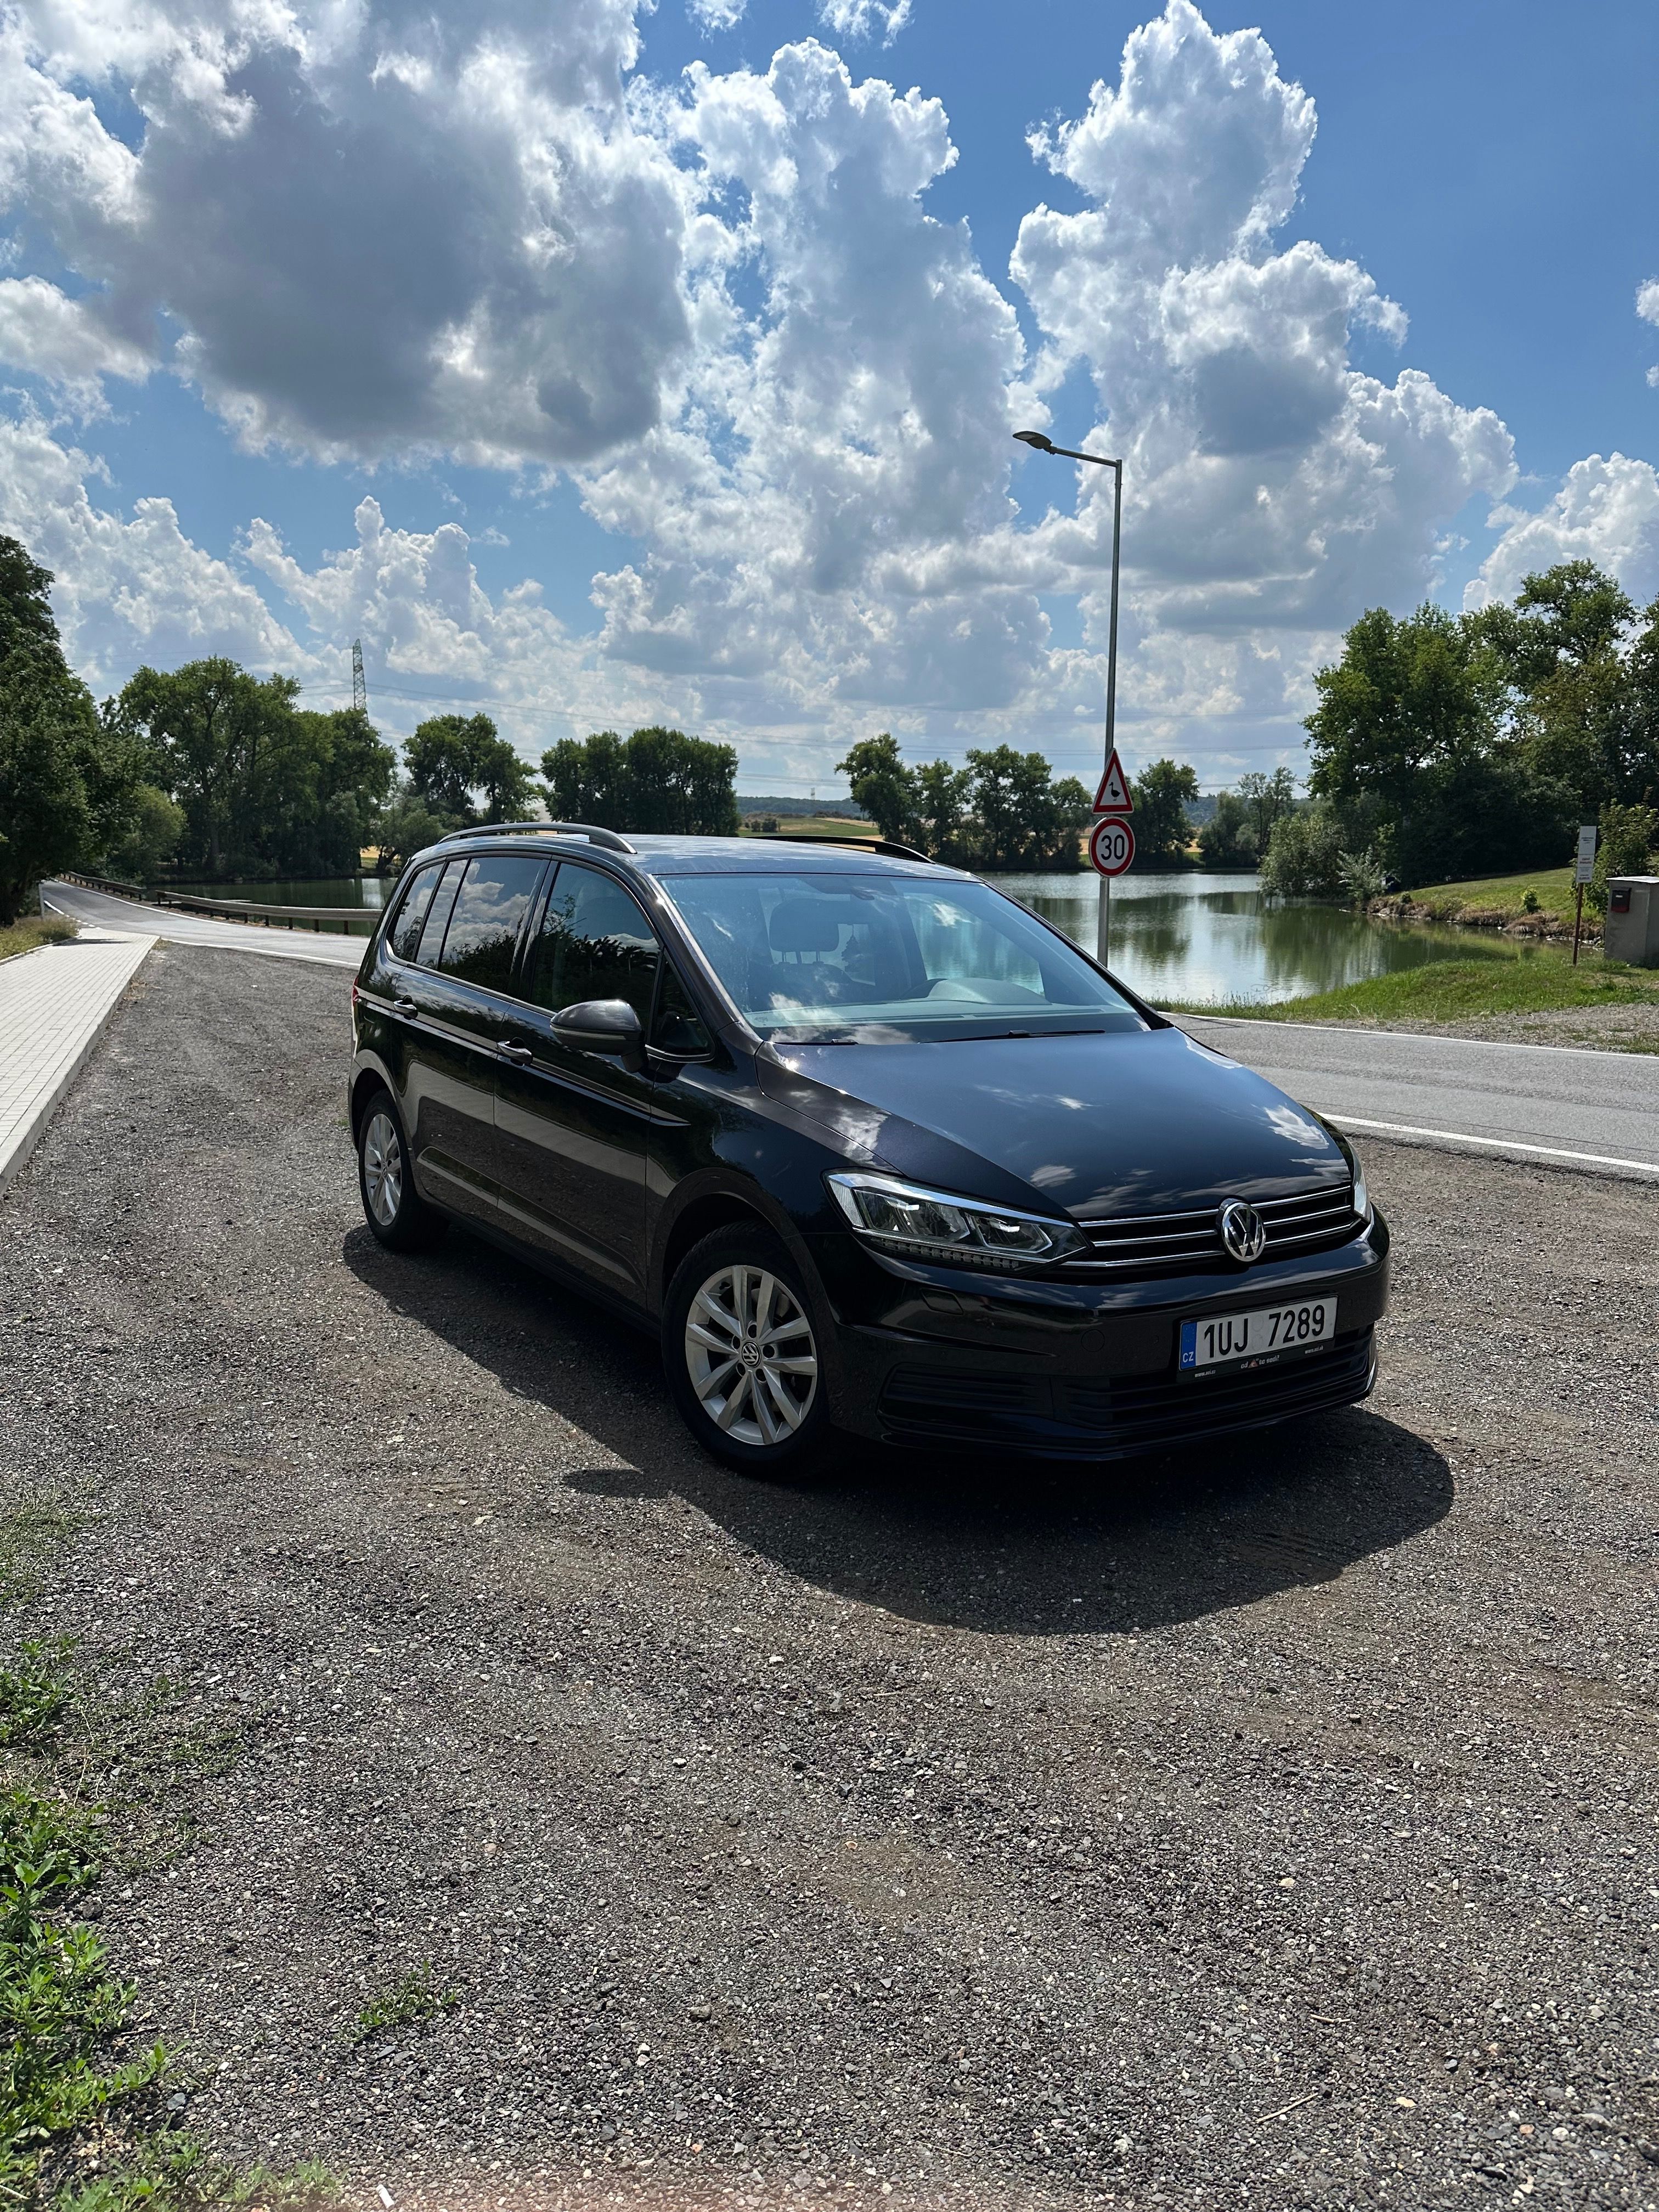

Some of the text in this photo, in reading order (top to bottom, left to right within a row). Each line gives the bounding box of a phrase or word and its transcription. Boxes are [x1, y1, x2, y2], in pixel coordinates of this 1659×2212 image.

[1101, 834, 1125, 860] 30
[1204, 1305, 1325, 1358] 1UJ 7289
[1182, 1351, 1194, 1363] CZ
